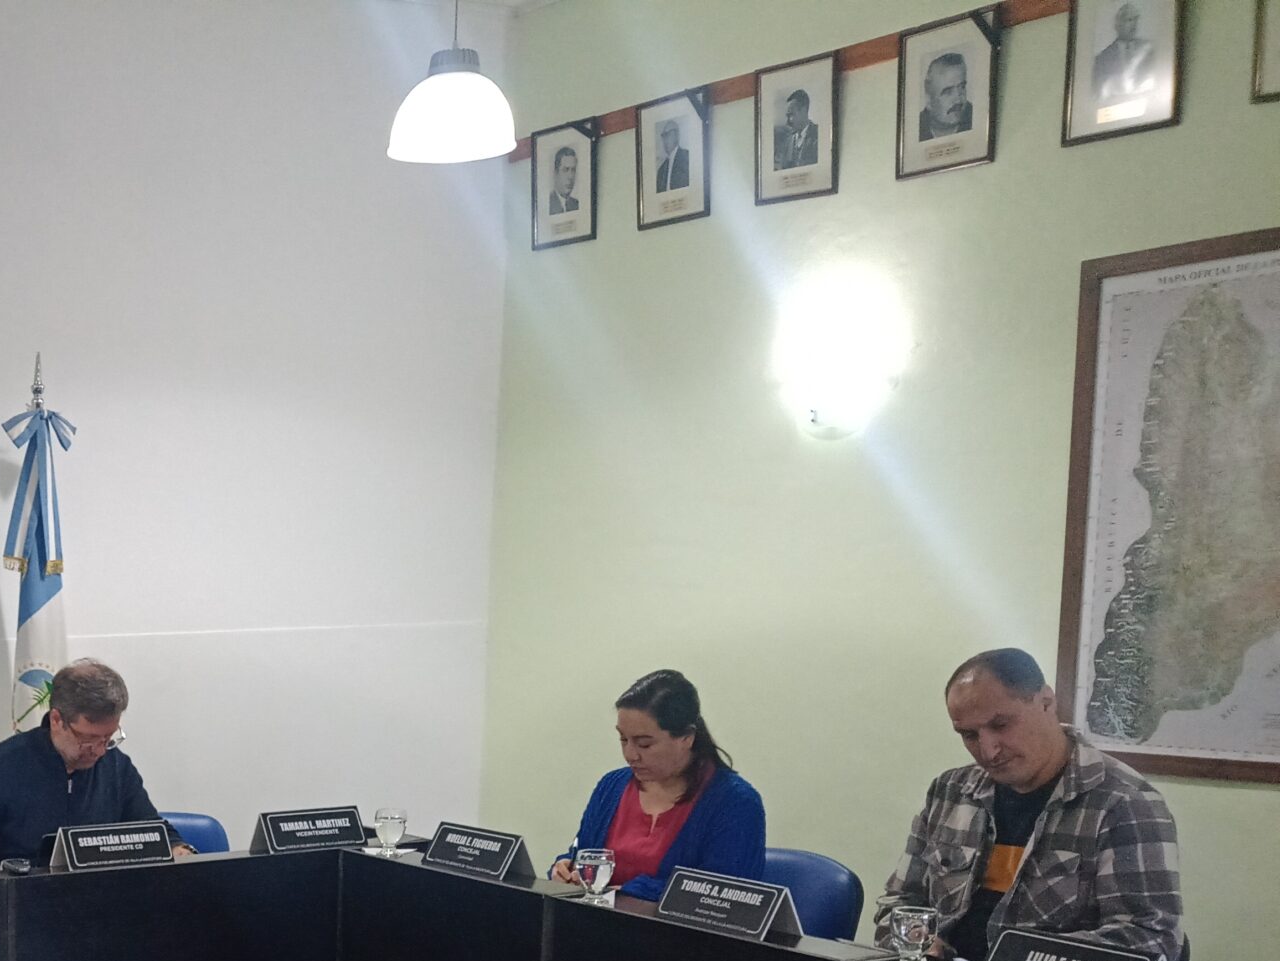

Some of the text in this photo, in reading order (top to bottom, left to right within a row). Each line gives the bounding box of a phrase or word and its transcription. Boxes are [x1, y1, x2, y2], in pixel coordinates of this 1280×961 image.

[279, 821, 309, 832] TAMARA
[78, 832, 161, 847] SEBASTIÁN RAIMONDO
[680, 879, 764, 906] TOMÁS A. ANDRADE
[700, 896, 731, 909] CONCEJAL
